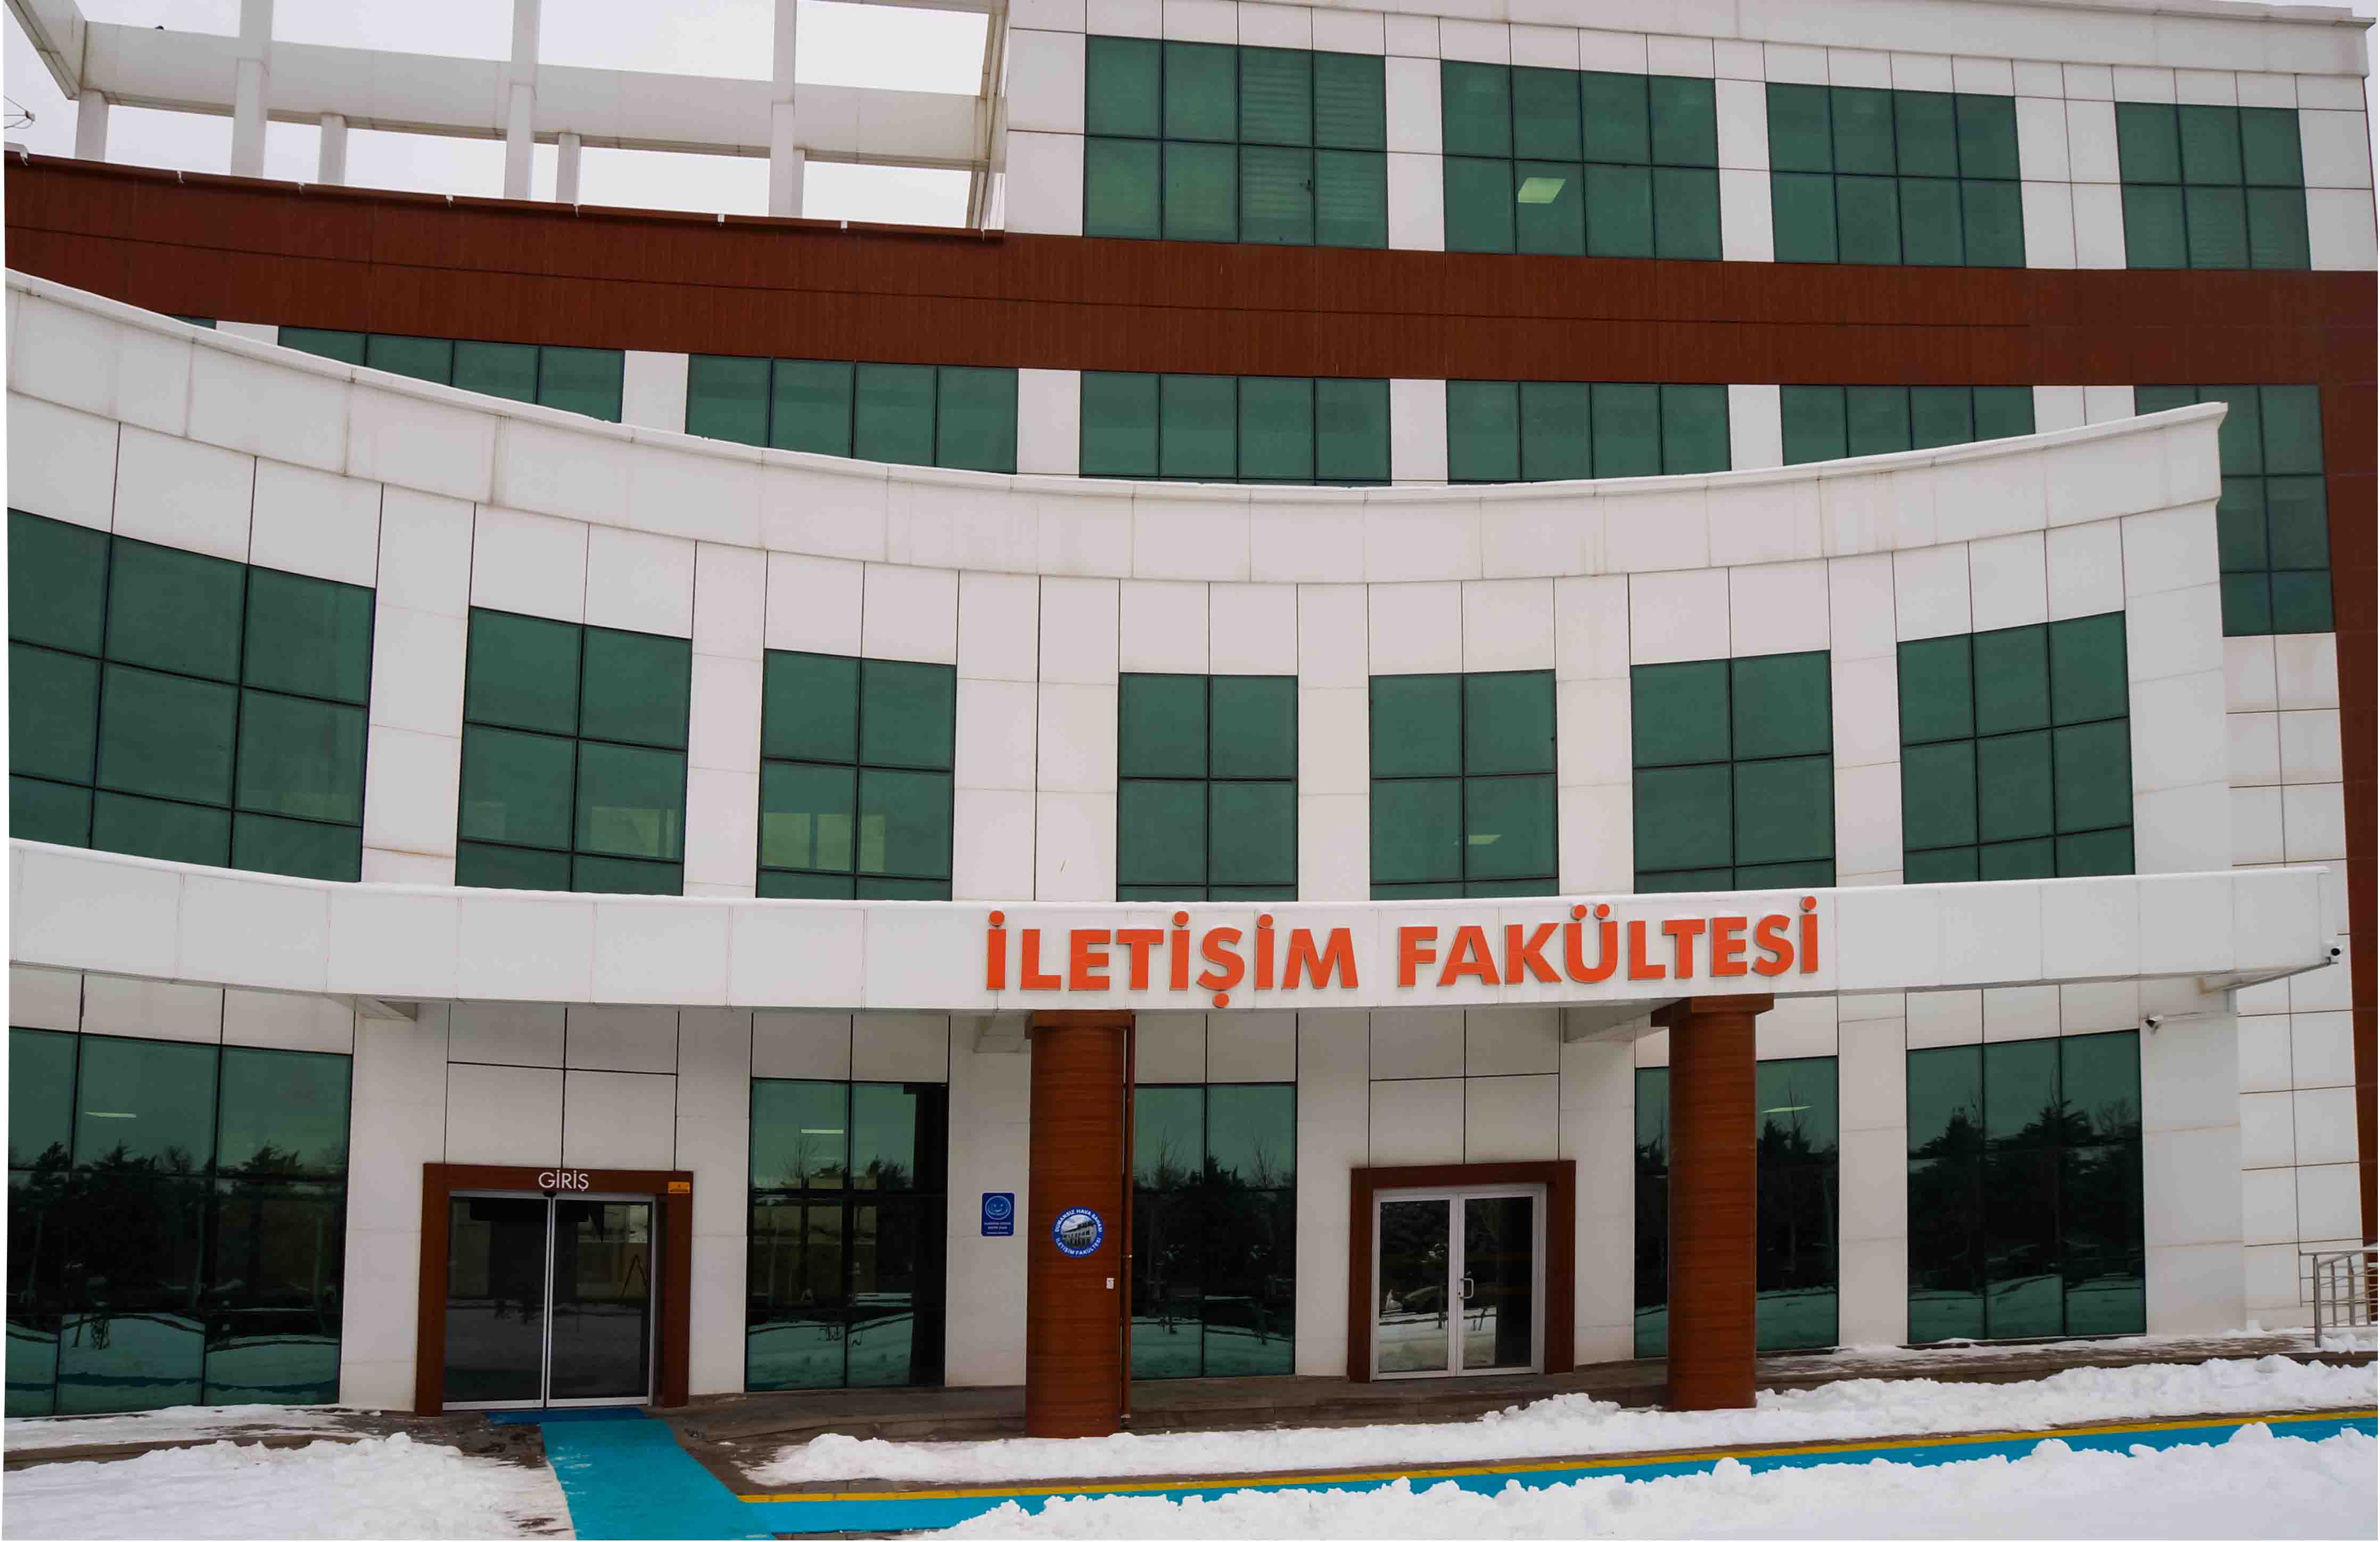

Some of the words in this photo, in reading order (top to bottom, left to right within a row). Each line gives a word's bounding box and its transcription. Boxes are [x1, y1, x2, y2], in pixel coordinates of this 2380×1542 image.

[986, 910, 1359, 1008] İLETİŞİM
[1397, 895, 1818, 987] FAKÜLTESİ
[538, 1169, 589, 1191] GİRİŞ
